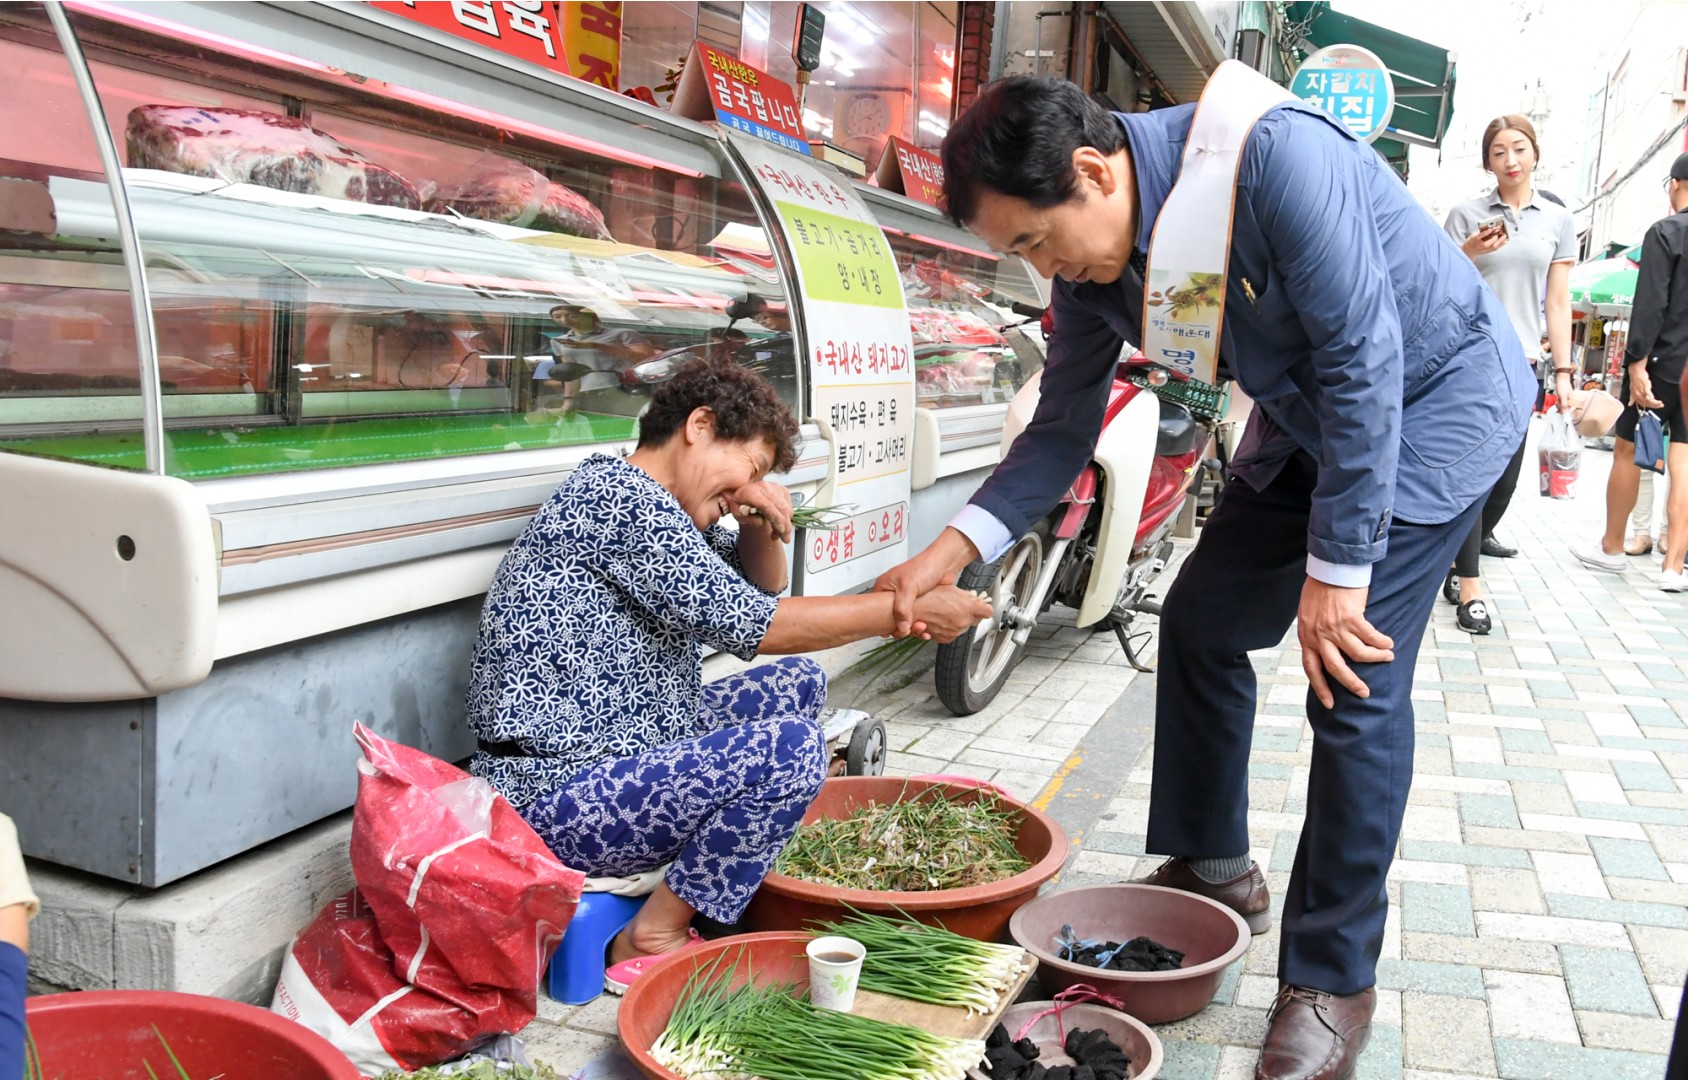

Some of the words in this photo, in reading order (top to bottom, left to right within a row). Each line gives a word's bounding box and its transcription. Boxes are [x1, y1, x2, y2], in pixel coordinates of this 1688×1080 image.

[707, 50, 758, 87] 국내산한우
[1306, 72, 1376, 94] 자갈치
[713, 73, 800, 135] 곰국팝니다
[764, 164, 815, 200] 국내산
[812, 180, 849, 210] 한우
[825, 340, 862, 375] 국내산
[868, 342, 910, 375] 돼지고기
[826, 521, 855, 563] 생닭
[879, 505, 904, 543] 오리
